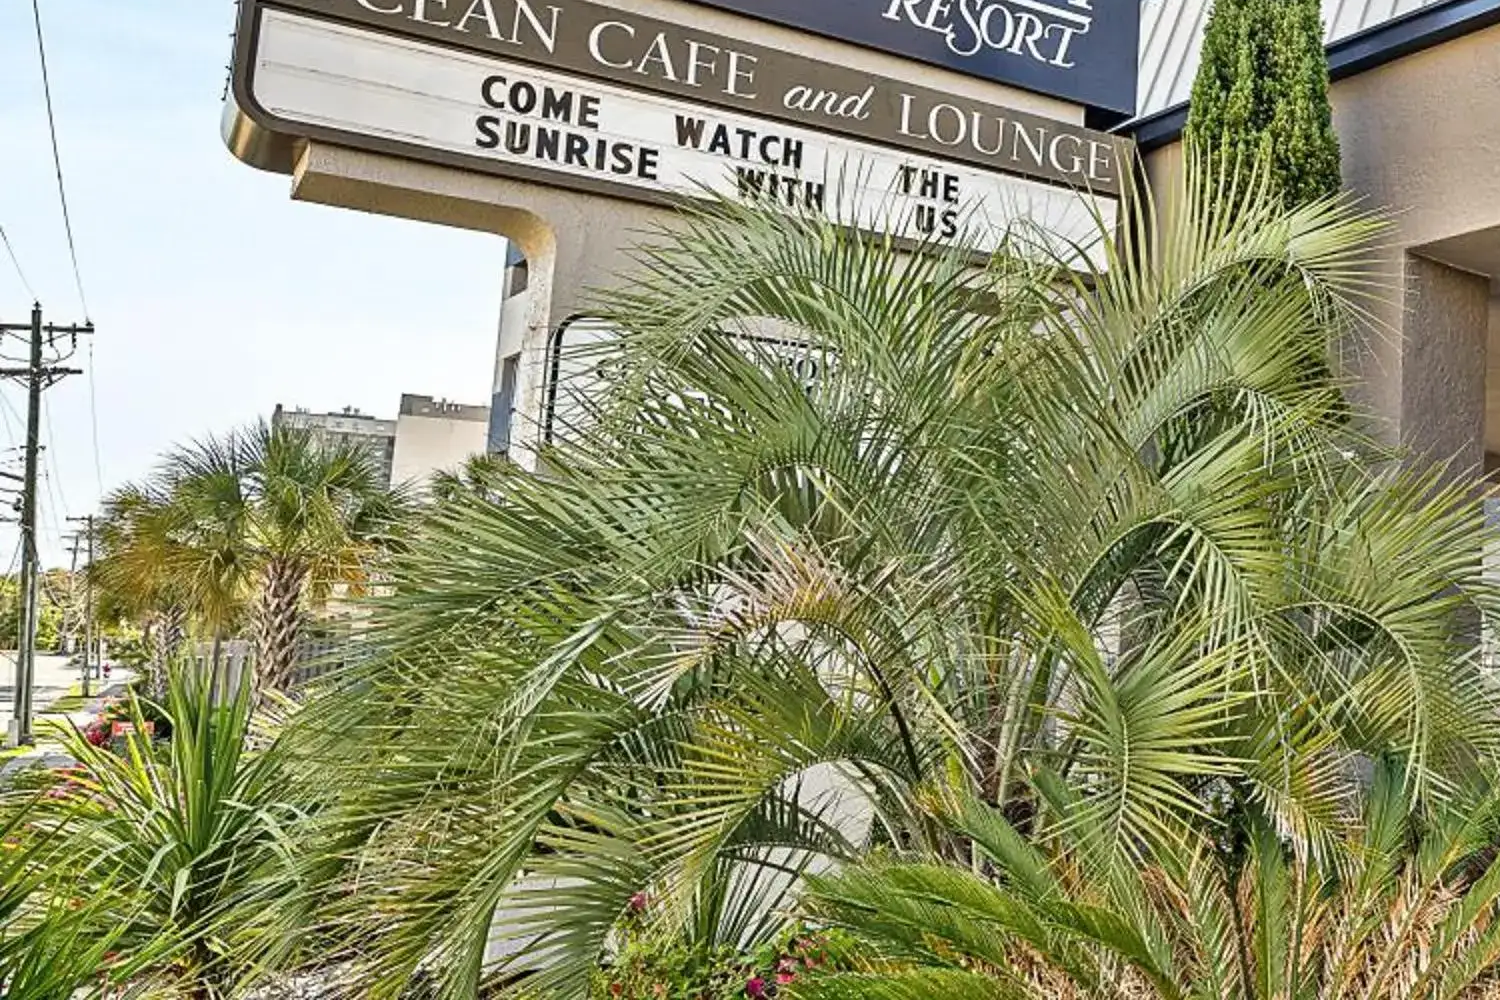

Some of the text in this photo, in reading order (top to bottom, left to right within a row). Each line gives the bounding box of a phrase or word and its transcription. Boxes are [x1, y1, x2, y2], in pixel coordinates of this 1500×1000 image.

[480, 75, 960, 205] COME WATCH THE
[587, 21, 759, 99] CAFE
[783, 85, 875, 121] and
[897, 93, 1114, 184] LOUNGE
[474, 115, 959, 239] SUNRISE WITH US
